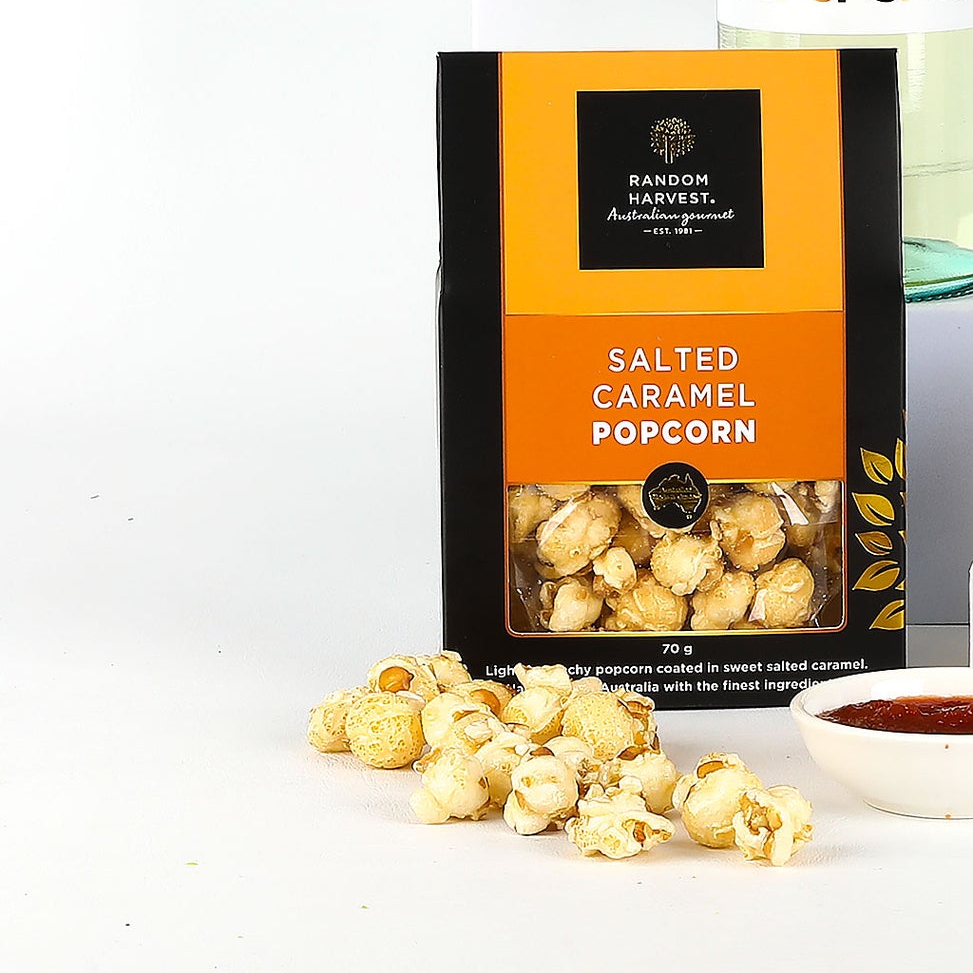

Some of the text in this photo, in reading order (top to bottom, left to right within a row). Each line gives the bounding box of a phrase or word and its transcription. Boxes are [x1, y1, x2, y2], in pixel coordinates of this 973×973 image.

[629, 174, 709, 187] RANDOM
[606, 206, 735, 227] Australian gourmet
[653, 227, 672, 235] EST.
[608, 346, 739, 372] SALTED
[592, 383, 756, 409] CARAMEL
[592, 419, 757, 446] POPCORN
[662, 643, 693, 656] 70 g
[485, 664, 515, 678] Ligh
[595, 663, 653, 677] popcorn
[656, 662, 703, 674] coated
[707, 662, 719, 673] in
[723, 661, 762, 673] sweet
[766, 659, 808, 672] salted
[811, 658, 868, 670] caramel.
[663, 680, 693, 693] with
[696, 679, 719, 692] the
[723, 679, 760, 691] finest
[764, 677, 824, 692] ingredie
